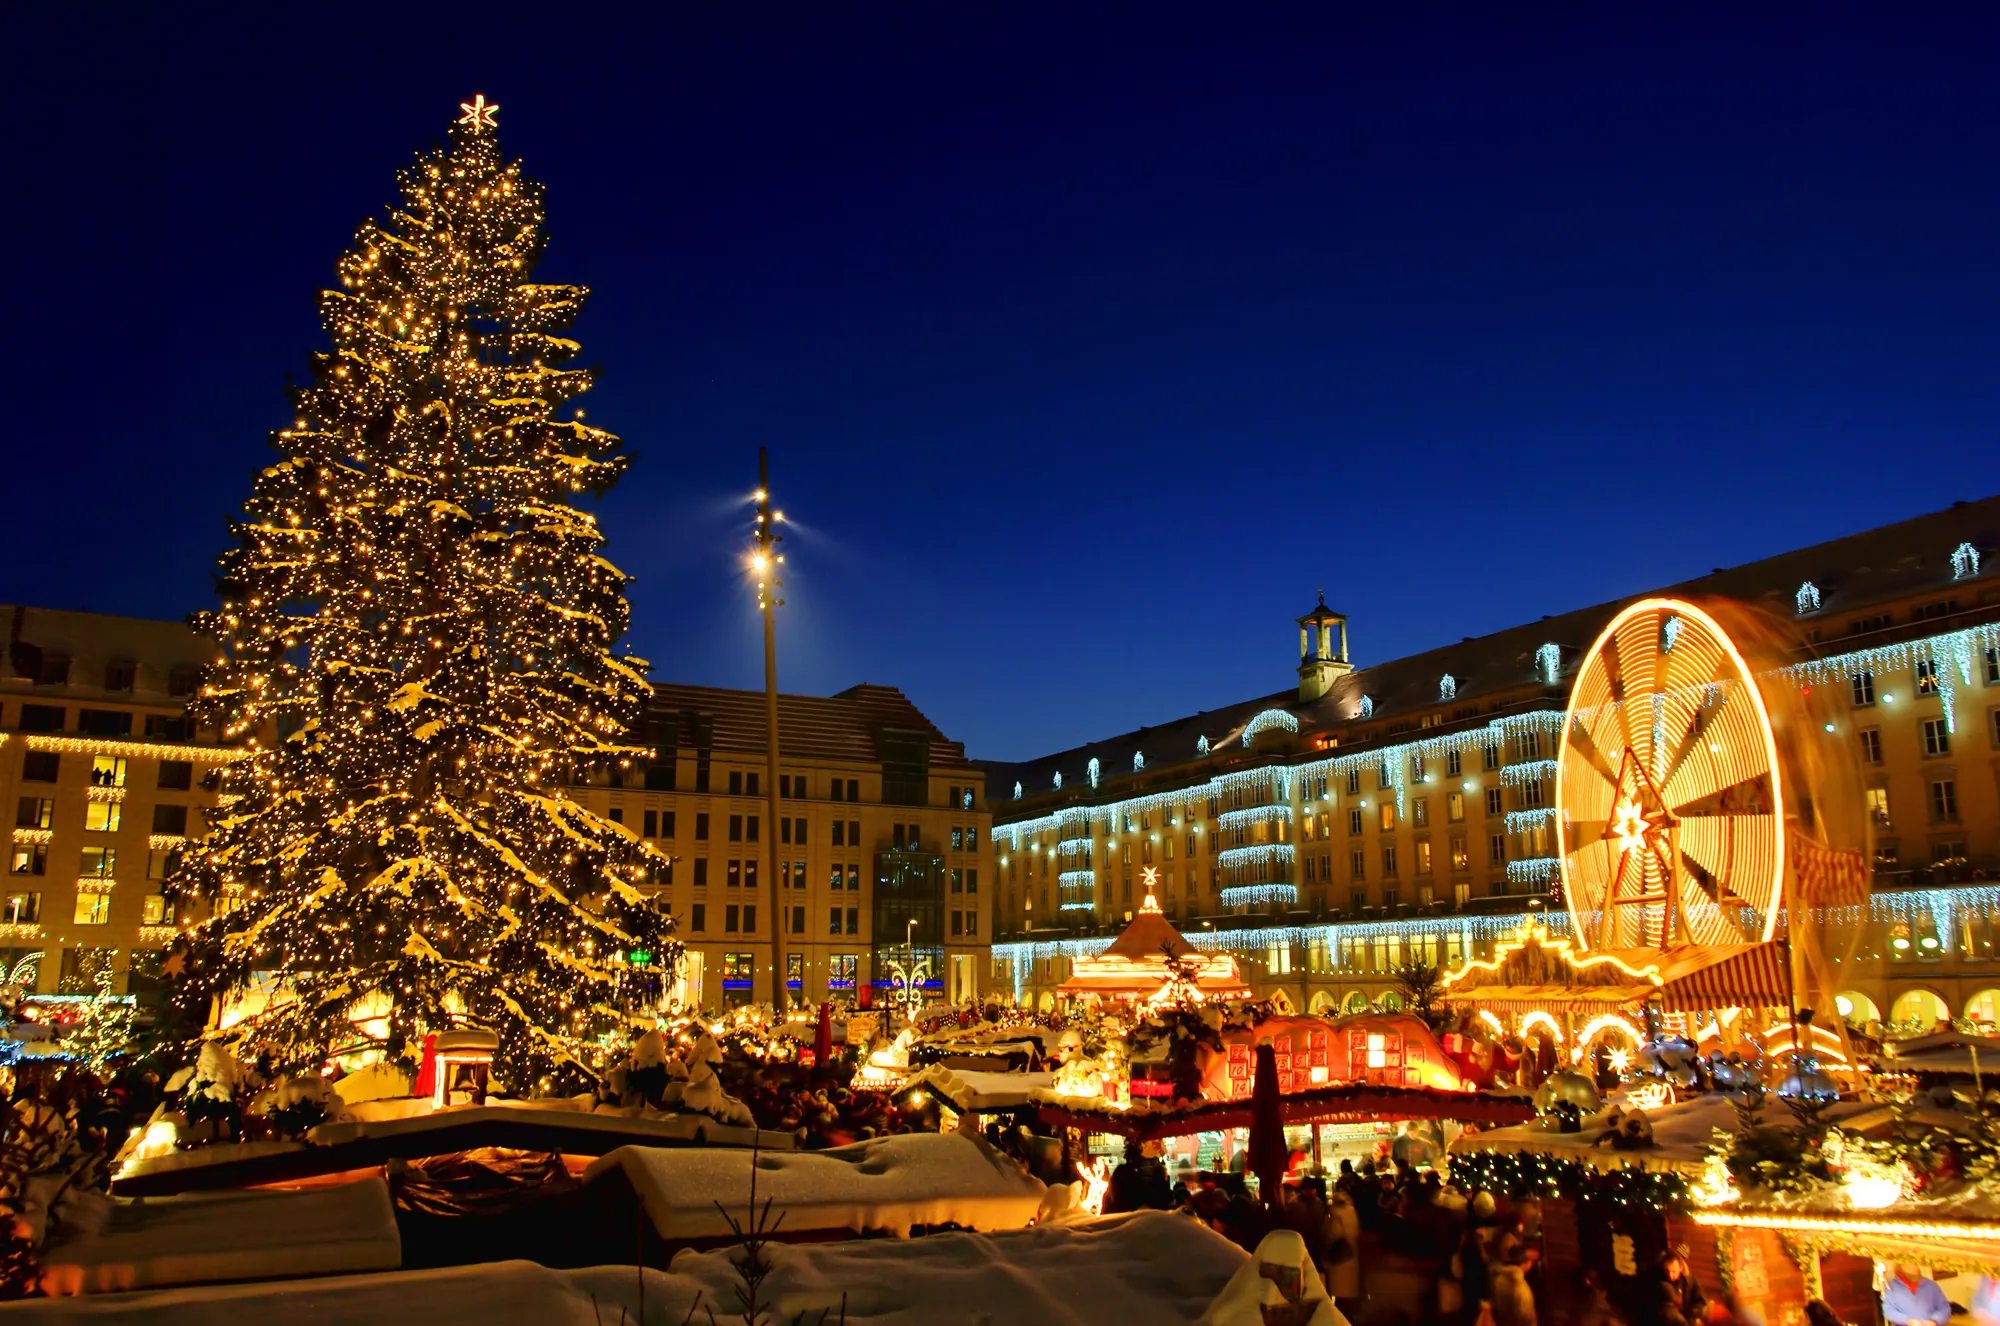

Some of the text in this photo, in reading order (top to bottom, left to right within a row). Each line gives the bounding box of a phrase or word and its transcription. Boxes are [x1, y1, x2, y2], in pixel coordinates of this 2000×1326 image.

[1277, 1042, 1287, 1051] 16
[1232, 1048, 1244, 1058] 22
[1295, 1056, 1303, 1066] 5
[1231, 1066, 1243, 1076] 10
[1280, 1075, 1287, 1085] 7
[1234, 1082, 1246, 1093] 14
